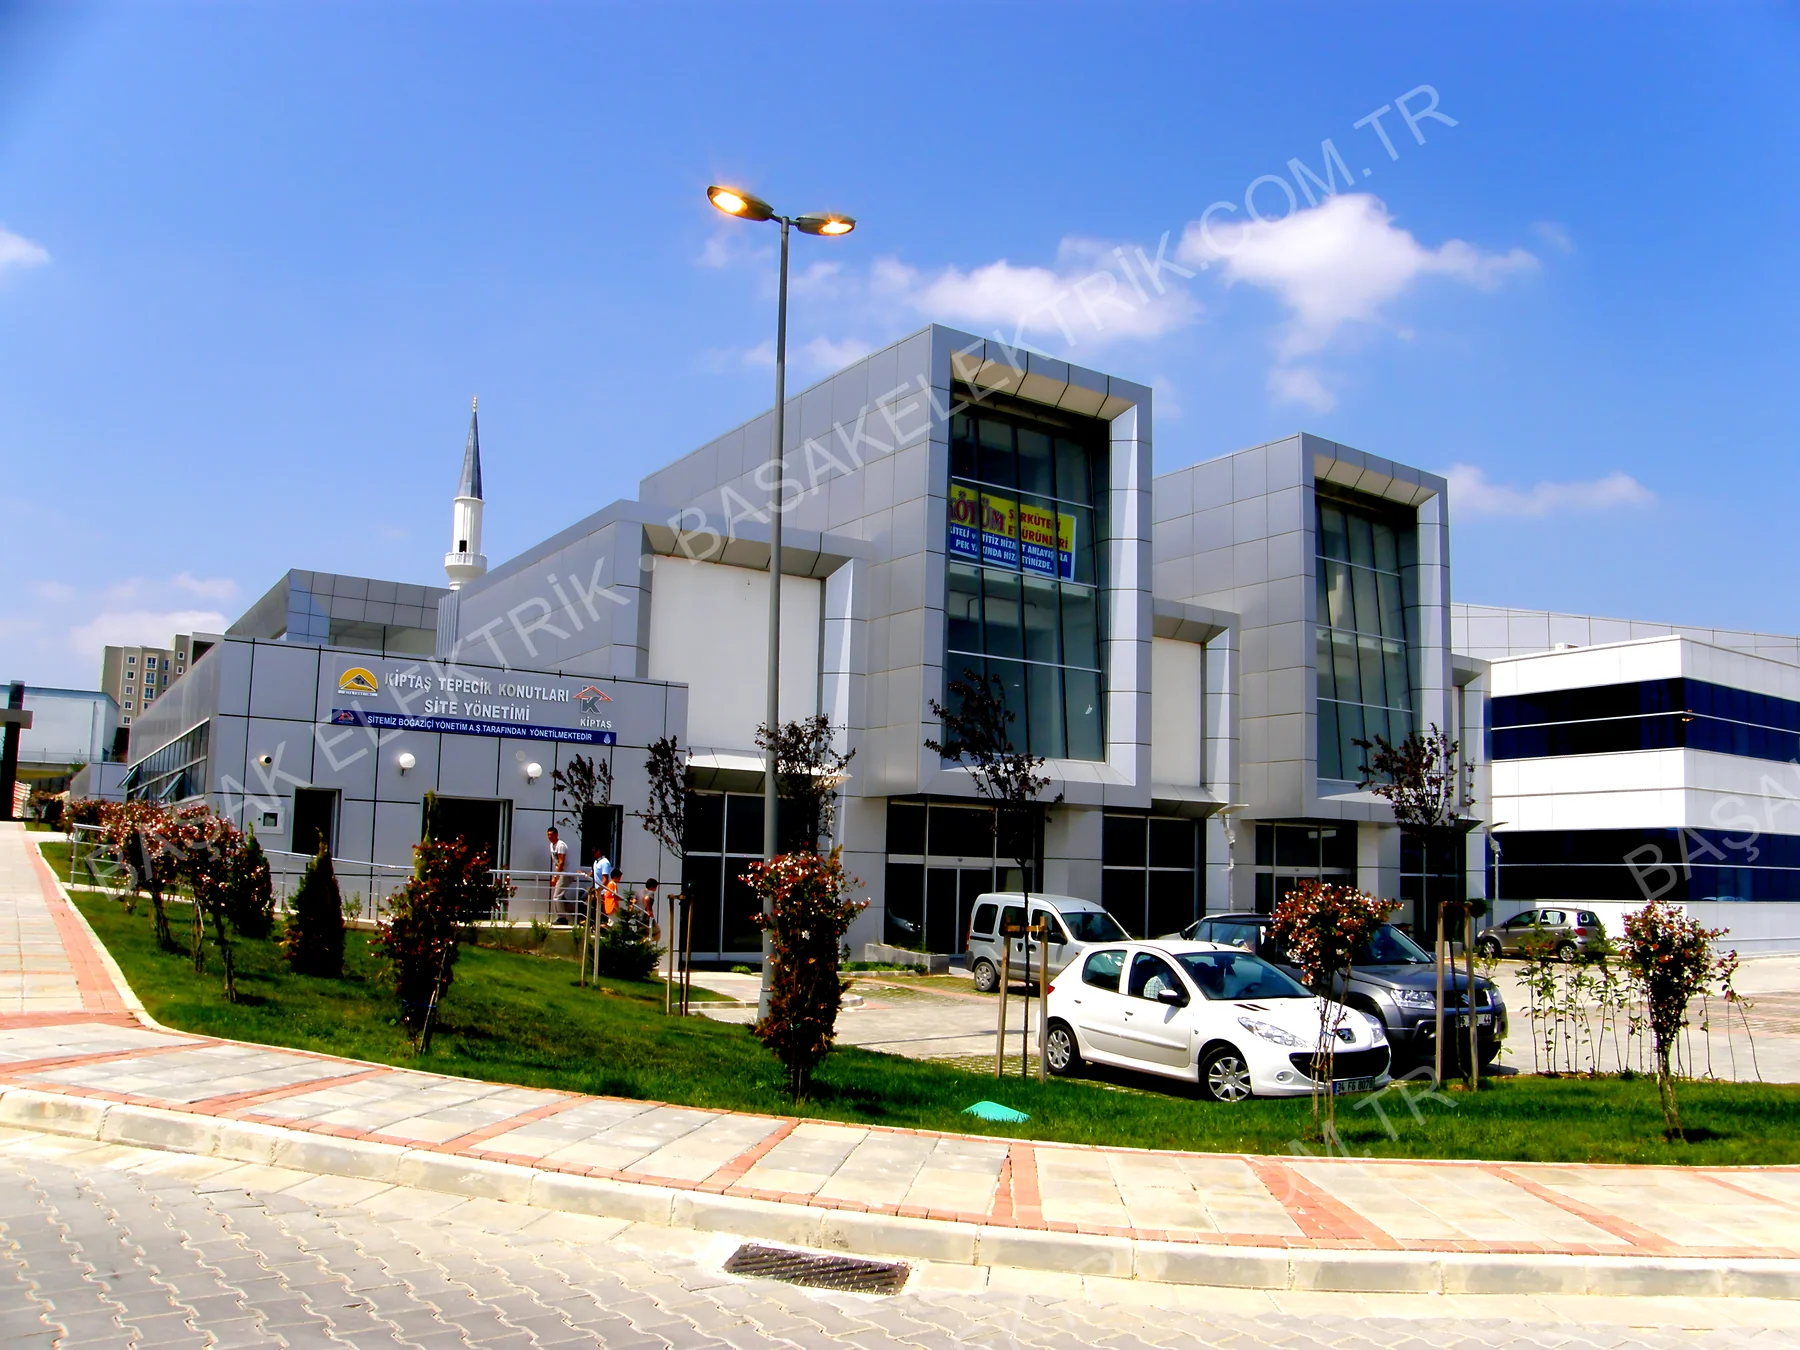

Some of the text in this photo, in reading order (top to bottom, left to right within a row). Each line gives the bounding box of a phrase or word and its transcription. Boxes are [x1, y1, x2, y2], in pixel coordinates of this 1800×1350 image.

[385, 669, 569, 702] KİPTAŞ TEPECİK KONUTLARI
[424, 697, 530, 721] SİTE YÖNETİMİ
[367, 715, 397, 725] SİTEMİZ
[435, 719, 468, 731] YÖNETİM
